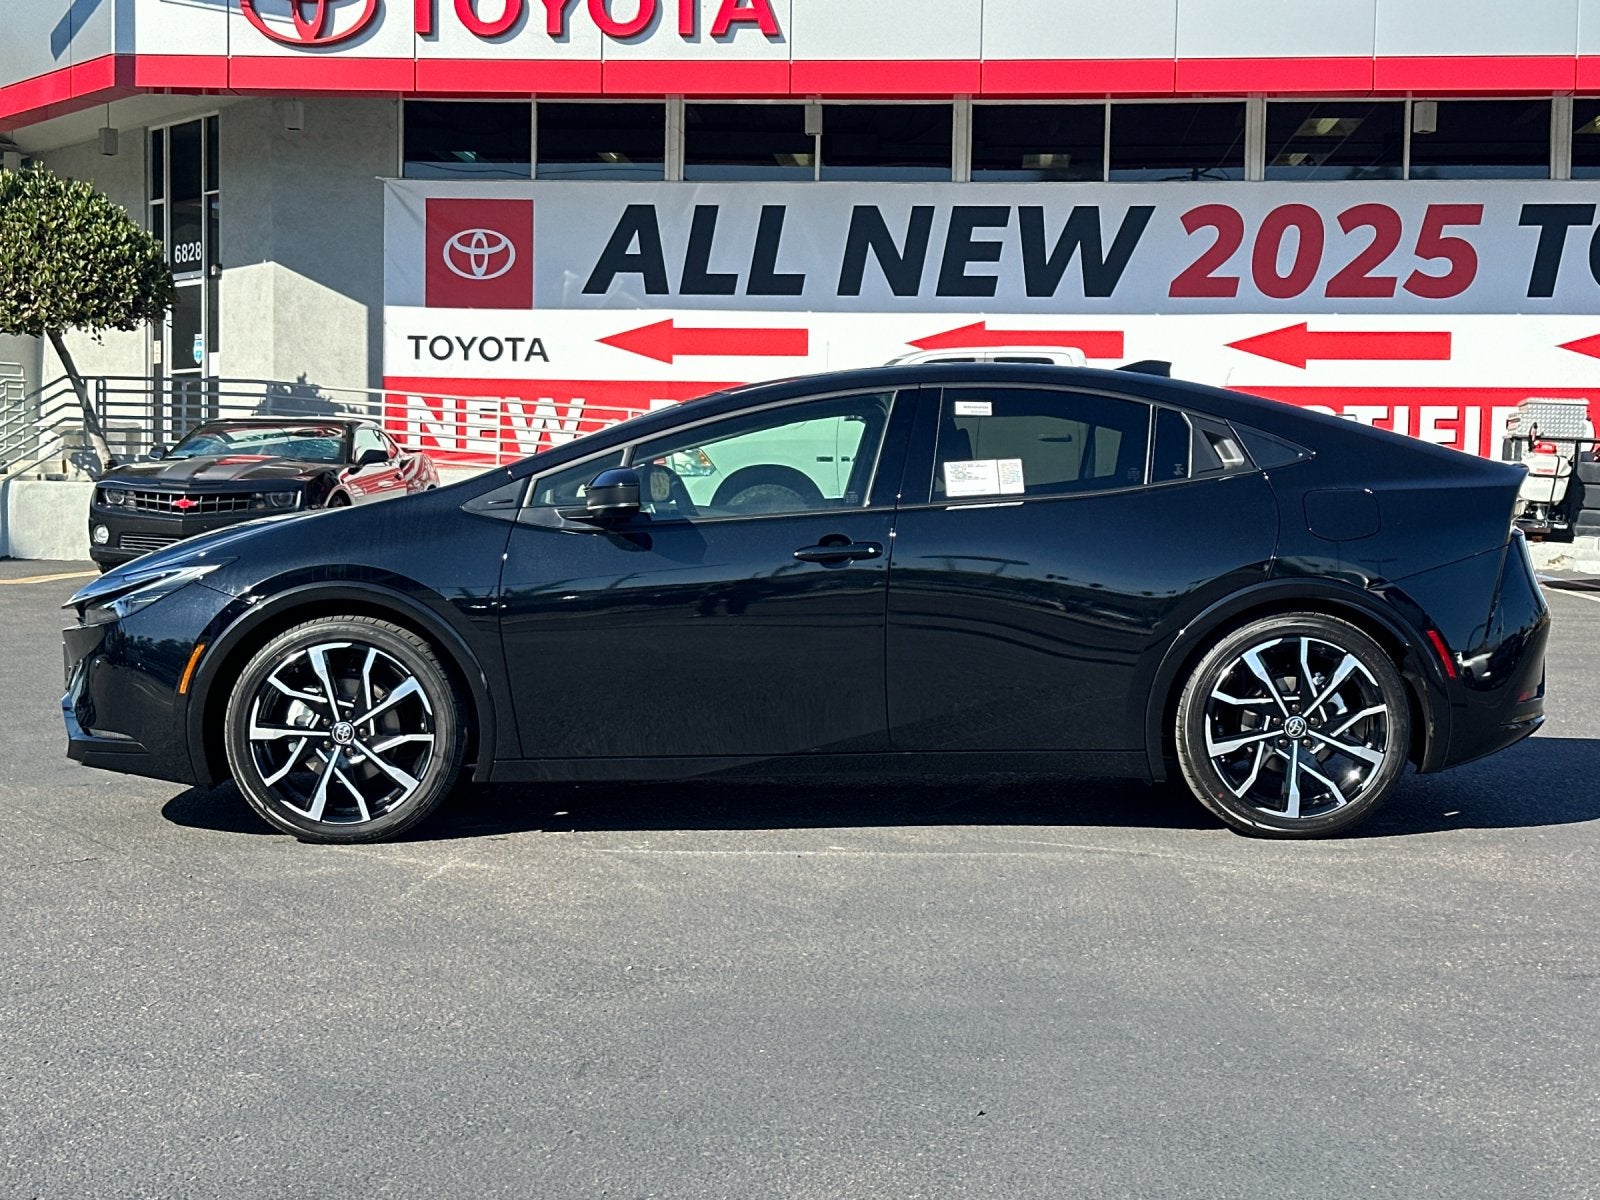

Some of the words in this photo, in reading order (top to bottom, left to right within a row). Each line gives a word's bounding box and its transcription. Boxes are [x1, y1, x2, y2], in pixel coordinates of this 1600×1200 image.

[174, 241, 202, 264] 6828
[581, 203, 806, 295] ALL
[836, 205, 1156, 298] NEW
[1168, 202, 1485, 299] 2025
[1518, 203, 1600, 298] T
[407, 335, 550, 363] TOYOTA
[406, 394, 586, 455] NEW
